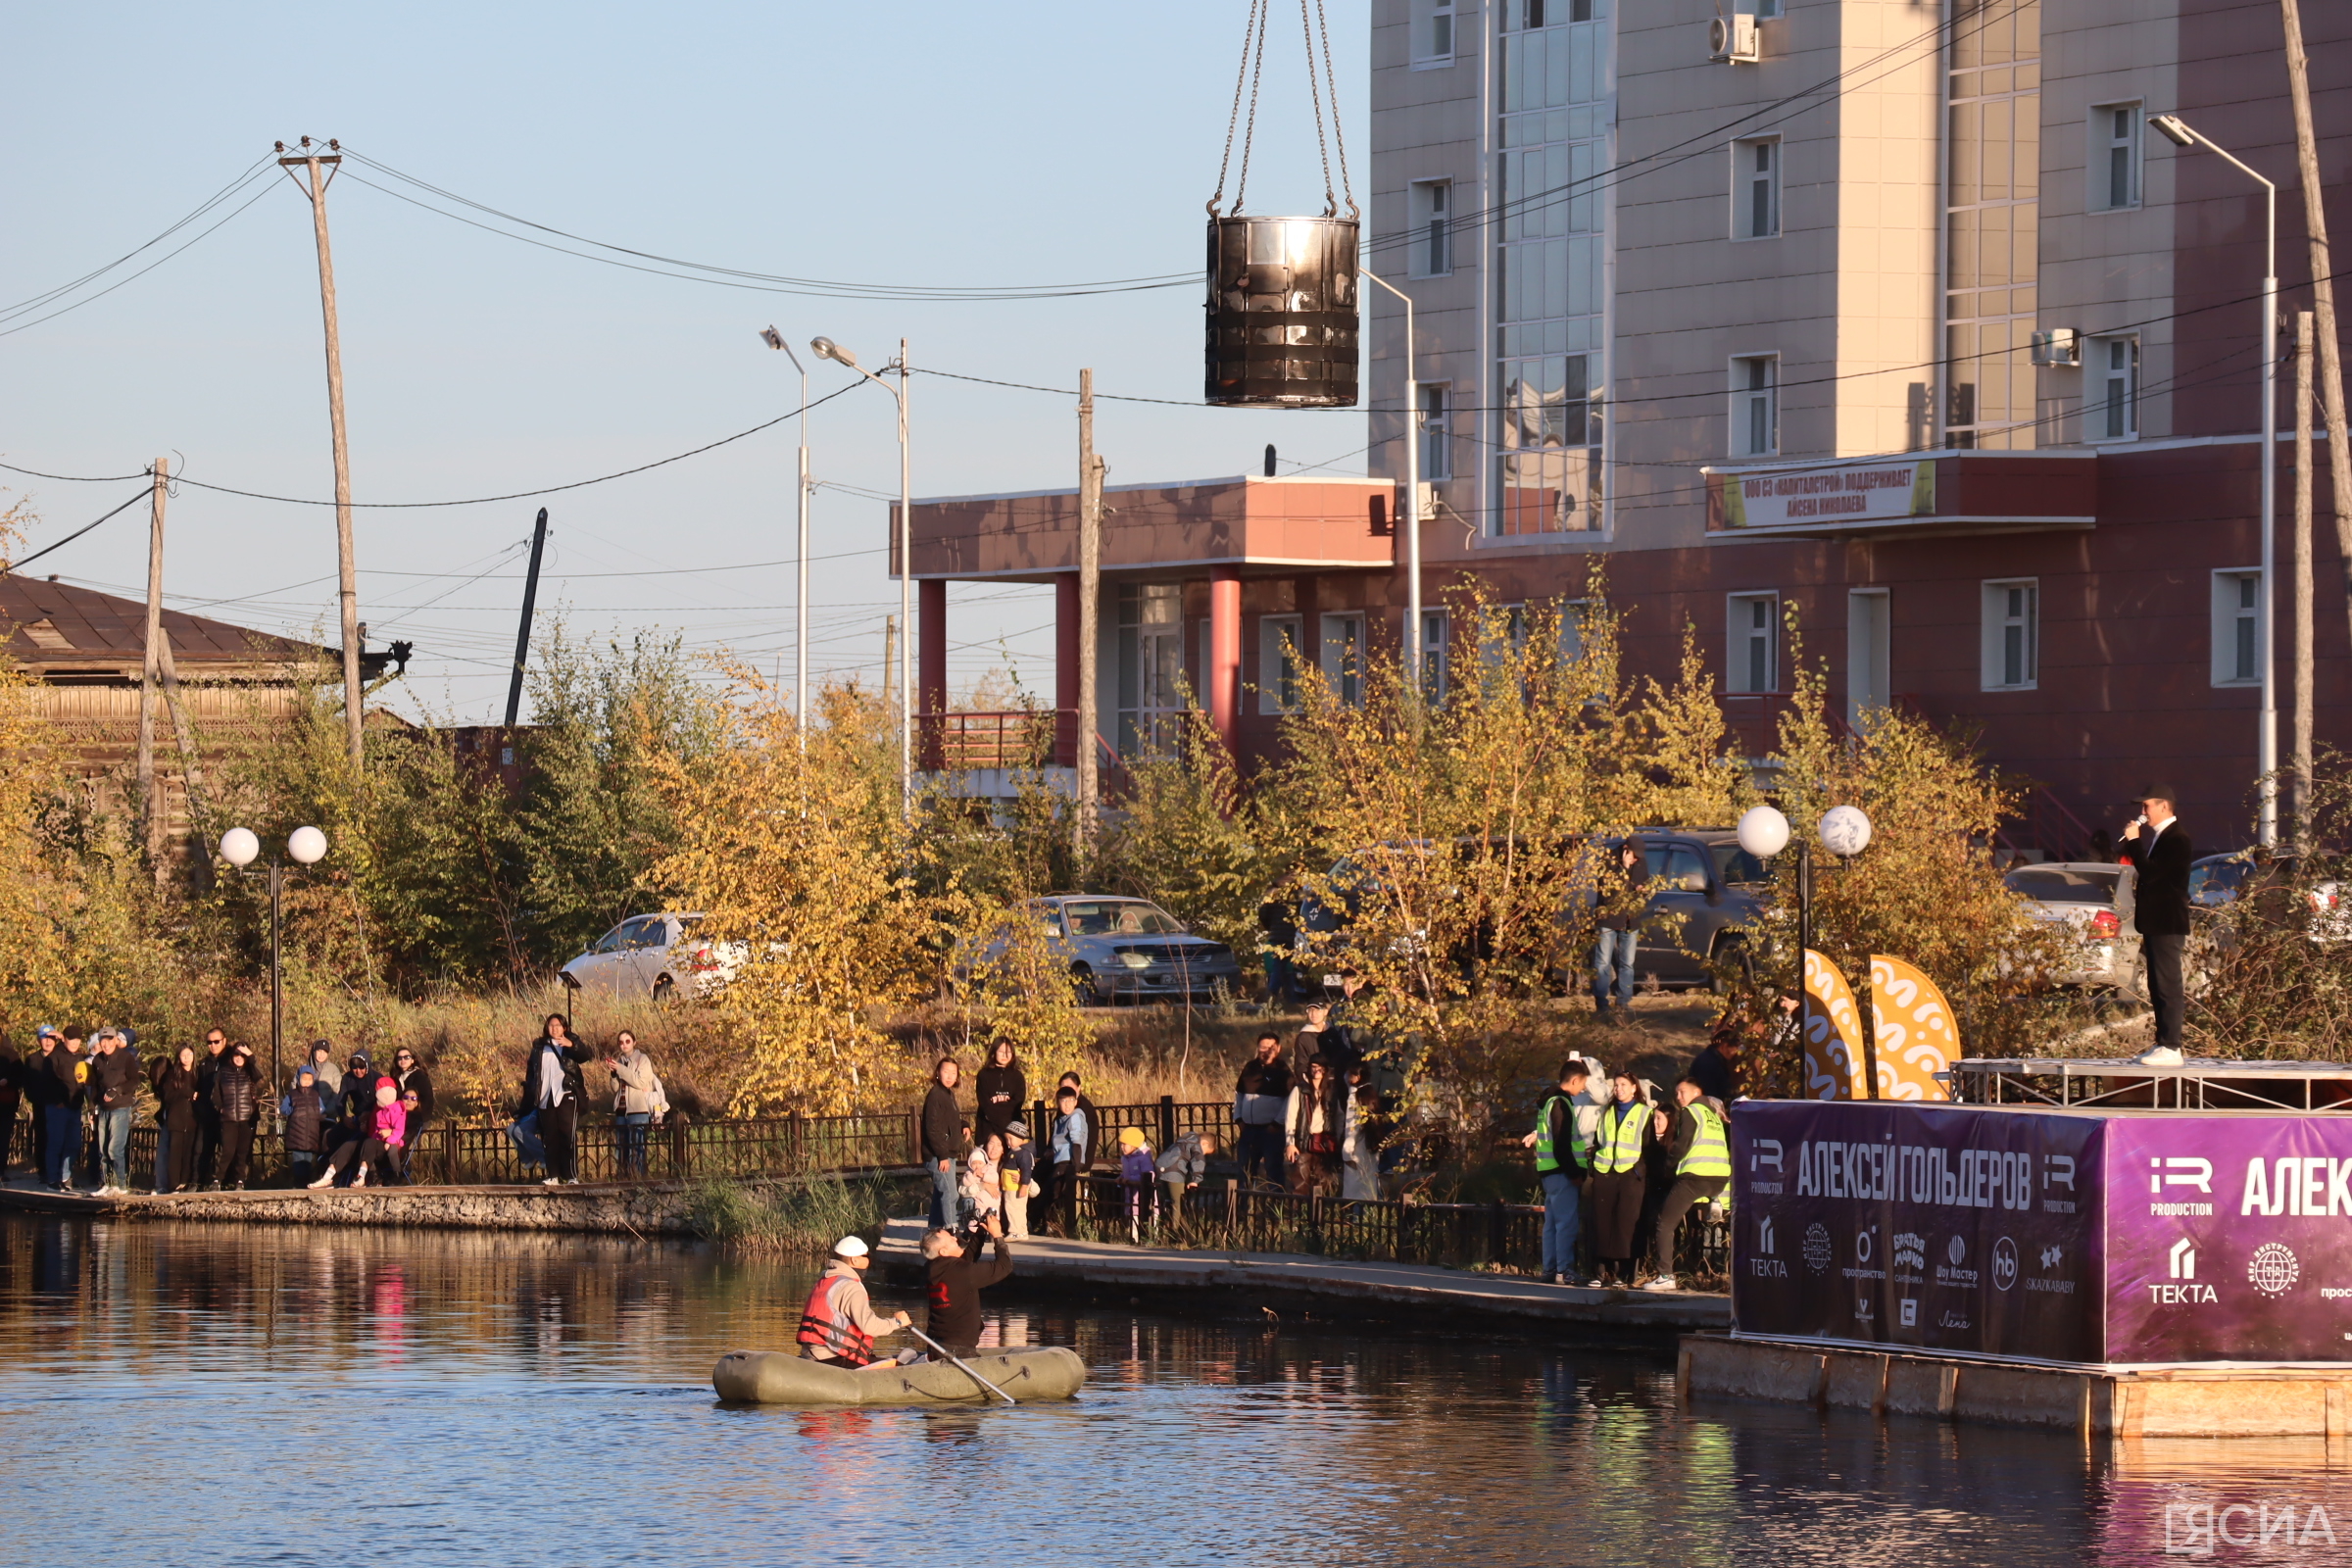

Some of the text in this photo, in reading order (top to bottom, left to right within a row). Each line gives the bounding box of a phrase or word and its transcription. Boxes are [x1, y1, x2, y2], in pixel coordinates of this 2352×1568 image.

[1744, 480, 1760, 499] ООО
[1845, 468, 1912, 493] ПОДДЕРЖИВАЕТ
[1787, 494, 1867, 517] АЙСЕНА НИКОЛАЕВА
[1797, 1133, 2032, 1211] АЛЕКСЕЙ ГОЛЬДЕРОВ
[1750, 1181, 1784, 1195] PRODUCTION
[2043, 1200, 2076, 1214] PRODUCTION
[2150, 1202, 2213, 1216] PRODUCTION
[1892, 1232, 1926, 1253] БРАТЬЯ
[1995, 1250, 2015, 1278] hb
[2253, 1243, 2300, 1283] ИНСТРУМЕНТА
[1841, 1267, 1886, 1280] пространство
[1949, 1266, 1979, 1284] Мастер
[2026, 1277, 2076, 1295] SKAZKABABY
[2148, 1284, 2219, 1303] ТЕКТА
[1938, 1309, 1971, 1329] Лена
